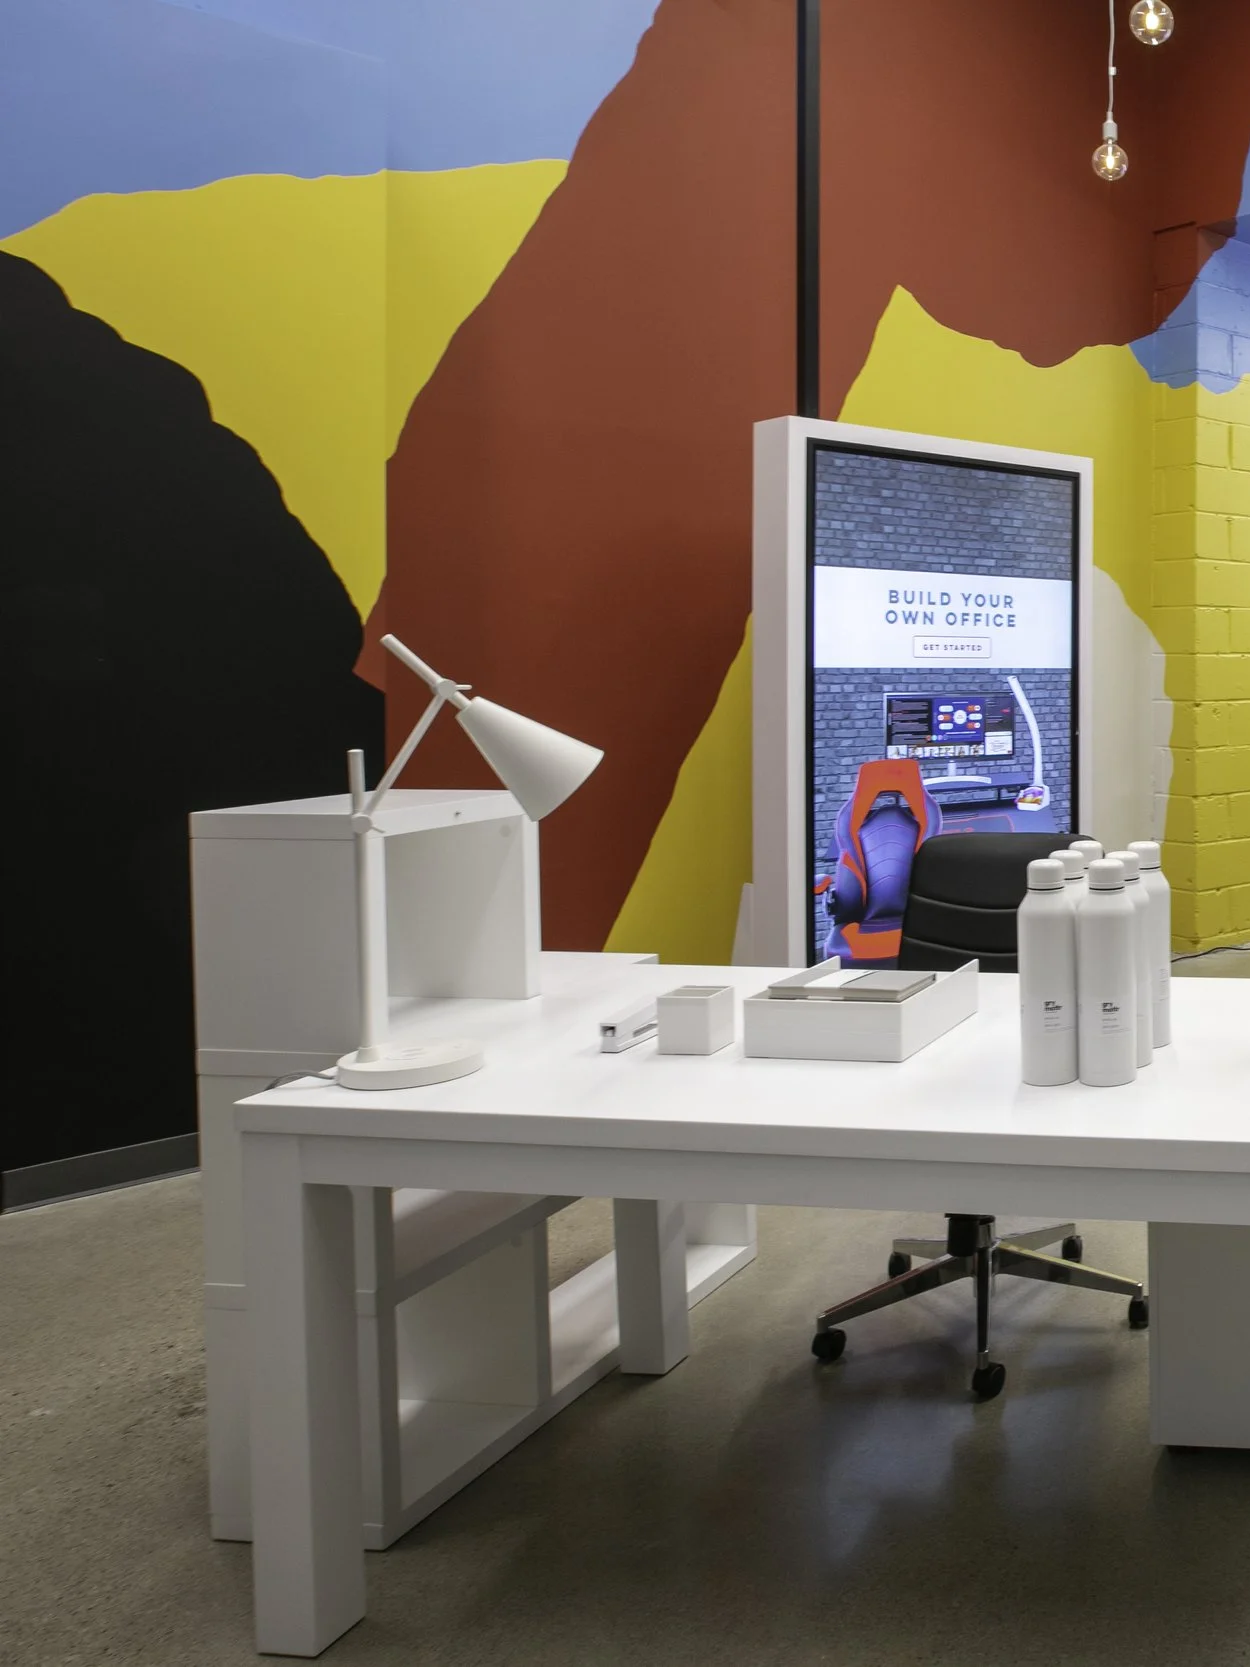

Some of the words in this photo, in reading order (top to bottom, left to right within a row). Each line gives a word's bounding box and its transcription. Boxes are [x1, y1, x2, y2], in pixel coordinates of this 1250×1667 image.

[888, 589, 952, 606] BUILD
[961, 592, 1014, 608] YOUR
[885, 609, 934, 625] OWN
[945, 611, 1016, 627] OFFICE
[943, 644, 983, 652] STARTED
